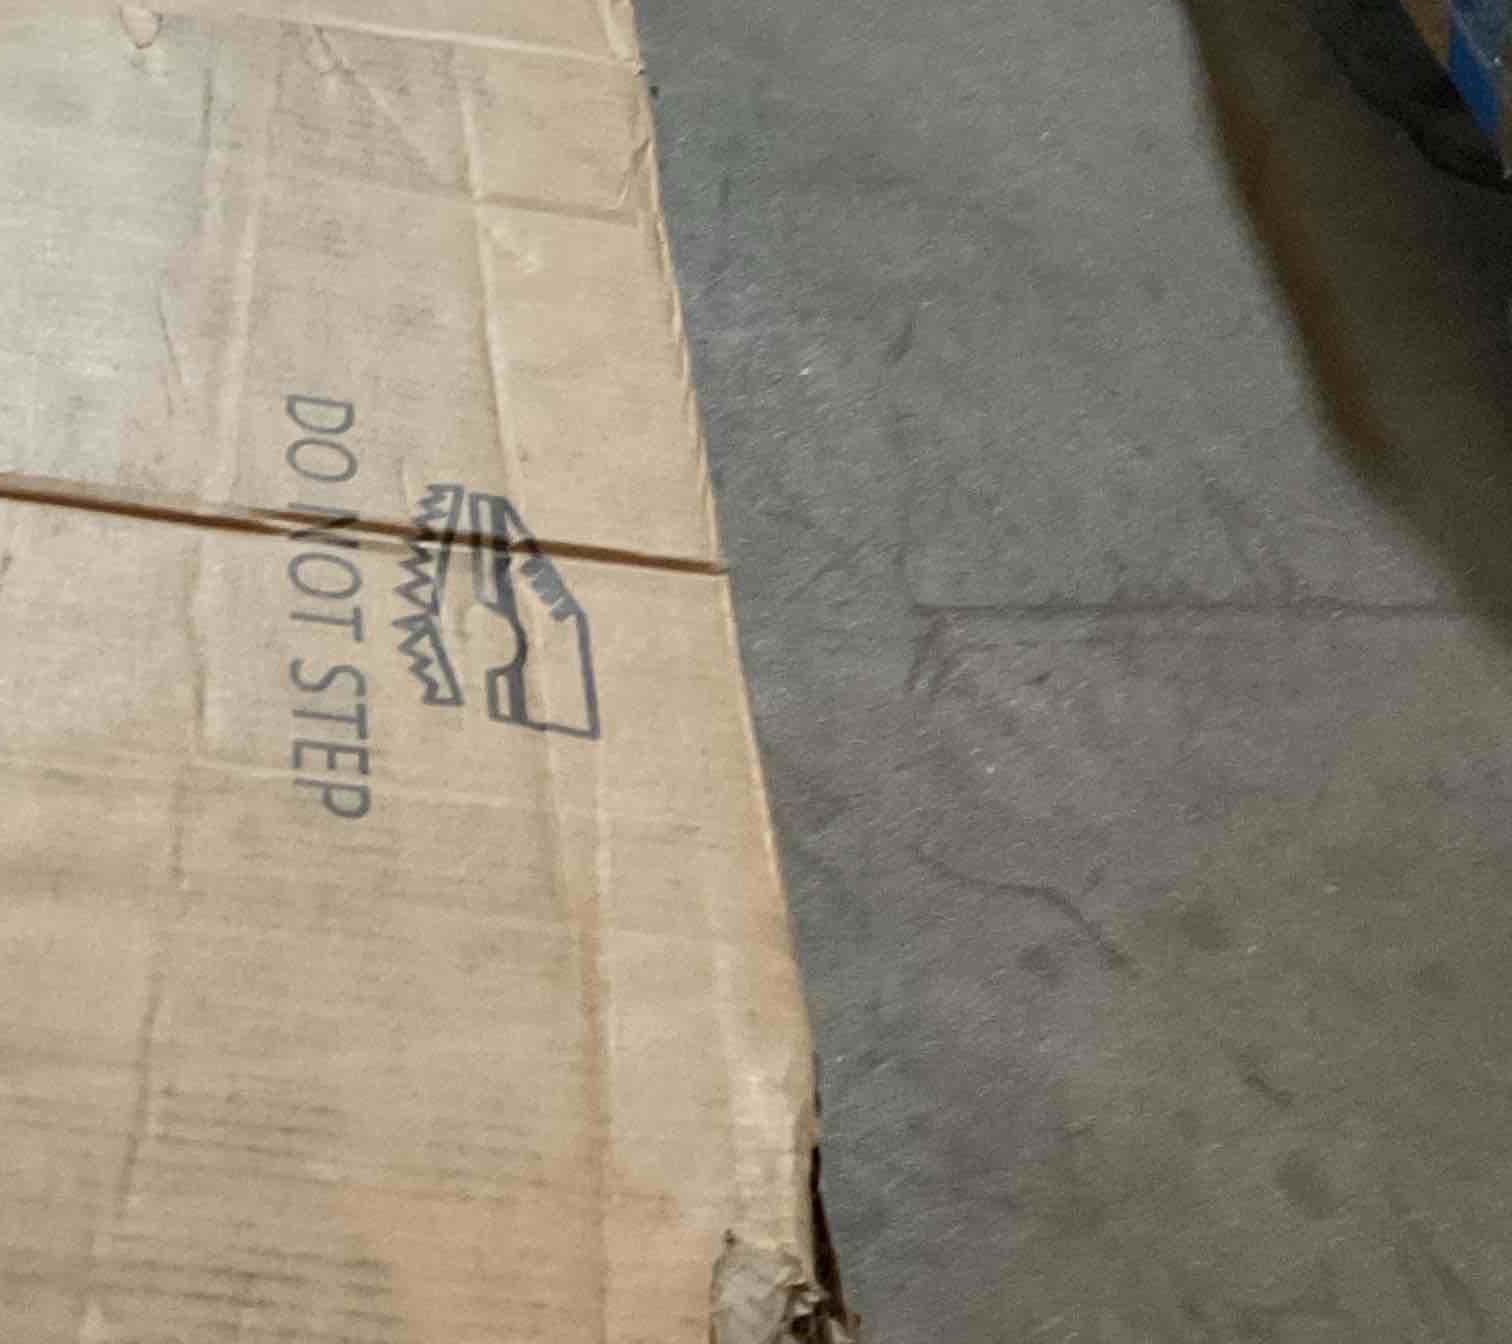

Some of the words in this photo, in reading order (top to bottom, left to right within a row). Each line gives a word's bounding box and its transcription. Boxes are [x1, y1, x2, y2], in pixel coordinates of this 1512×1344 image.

[286, 394, 358, 484] DO
[288, 504, 365, 642] NOT
[289, 659, 372, 820] STEP
